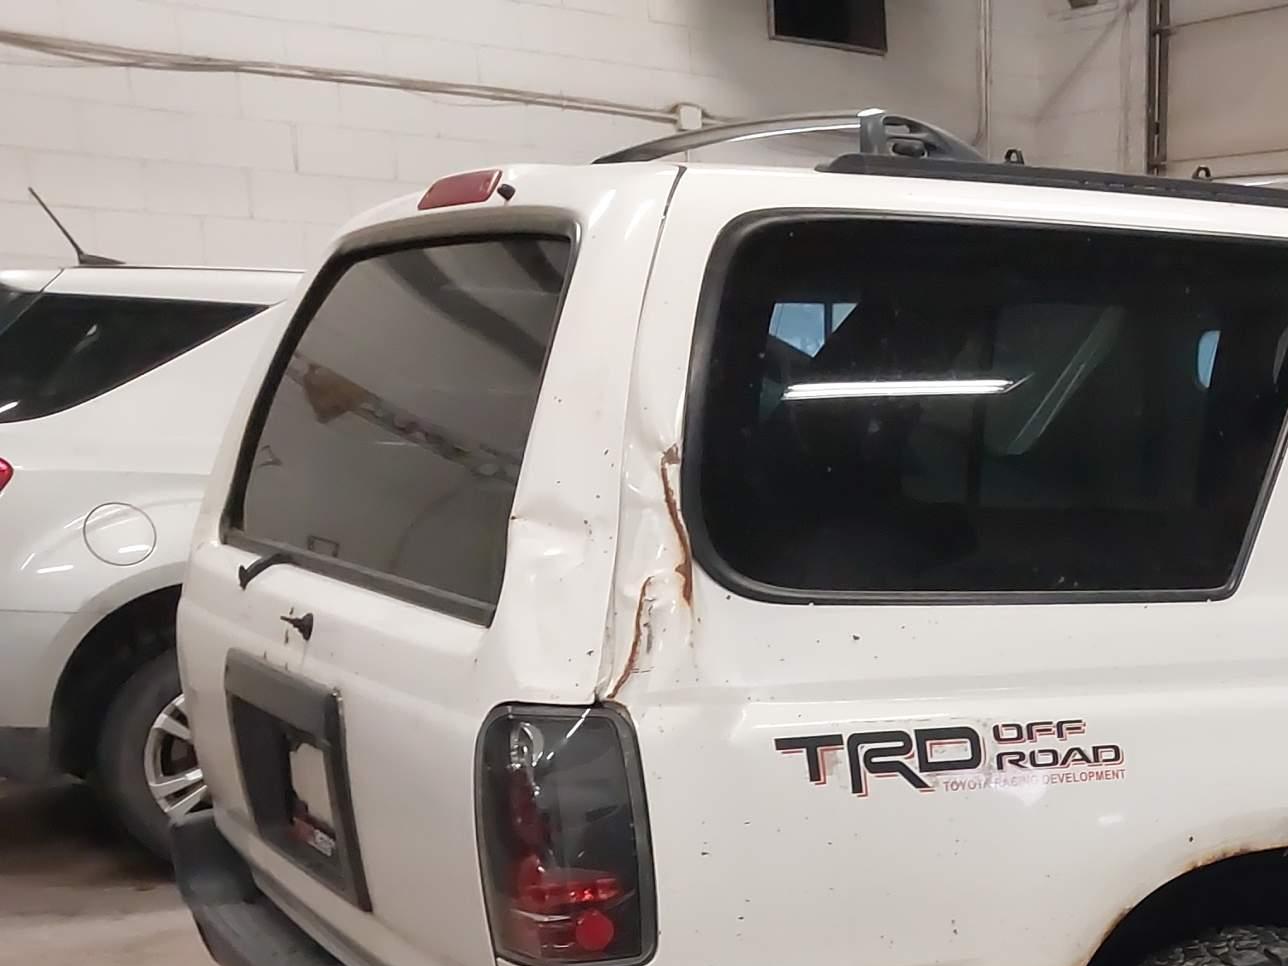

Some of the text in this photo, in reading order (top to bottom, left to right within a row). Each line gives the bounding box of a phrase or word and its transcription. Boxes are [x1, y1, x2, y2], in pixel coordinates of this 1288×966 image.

[991, 719, 1088, 745] OFF
[774, 725, 985, 798] TRD
[995, 744, 1127, 771] ROAD
[943, 775, 992, 792] TOYOTA
[1043, 768, 1126, 786] DEVELOPMENT
